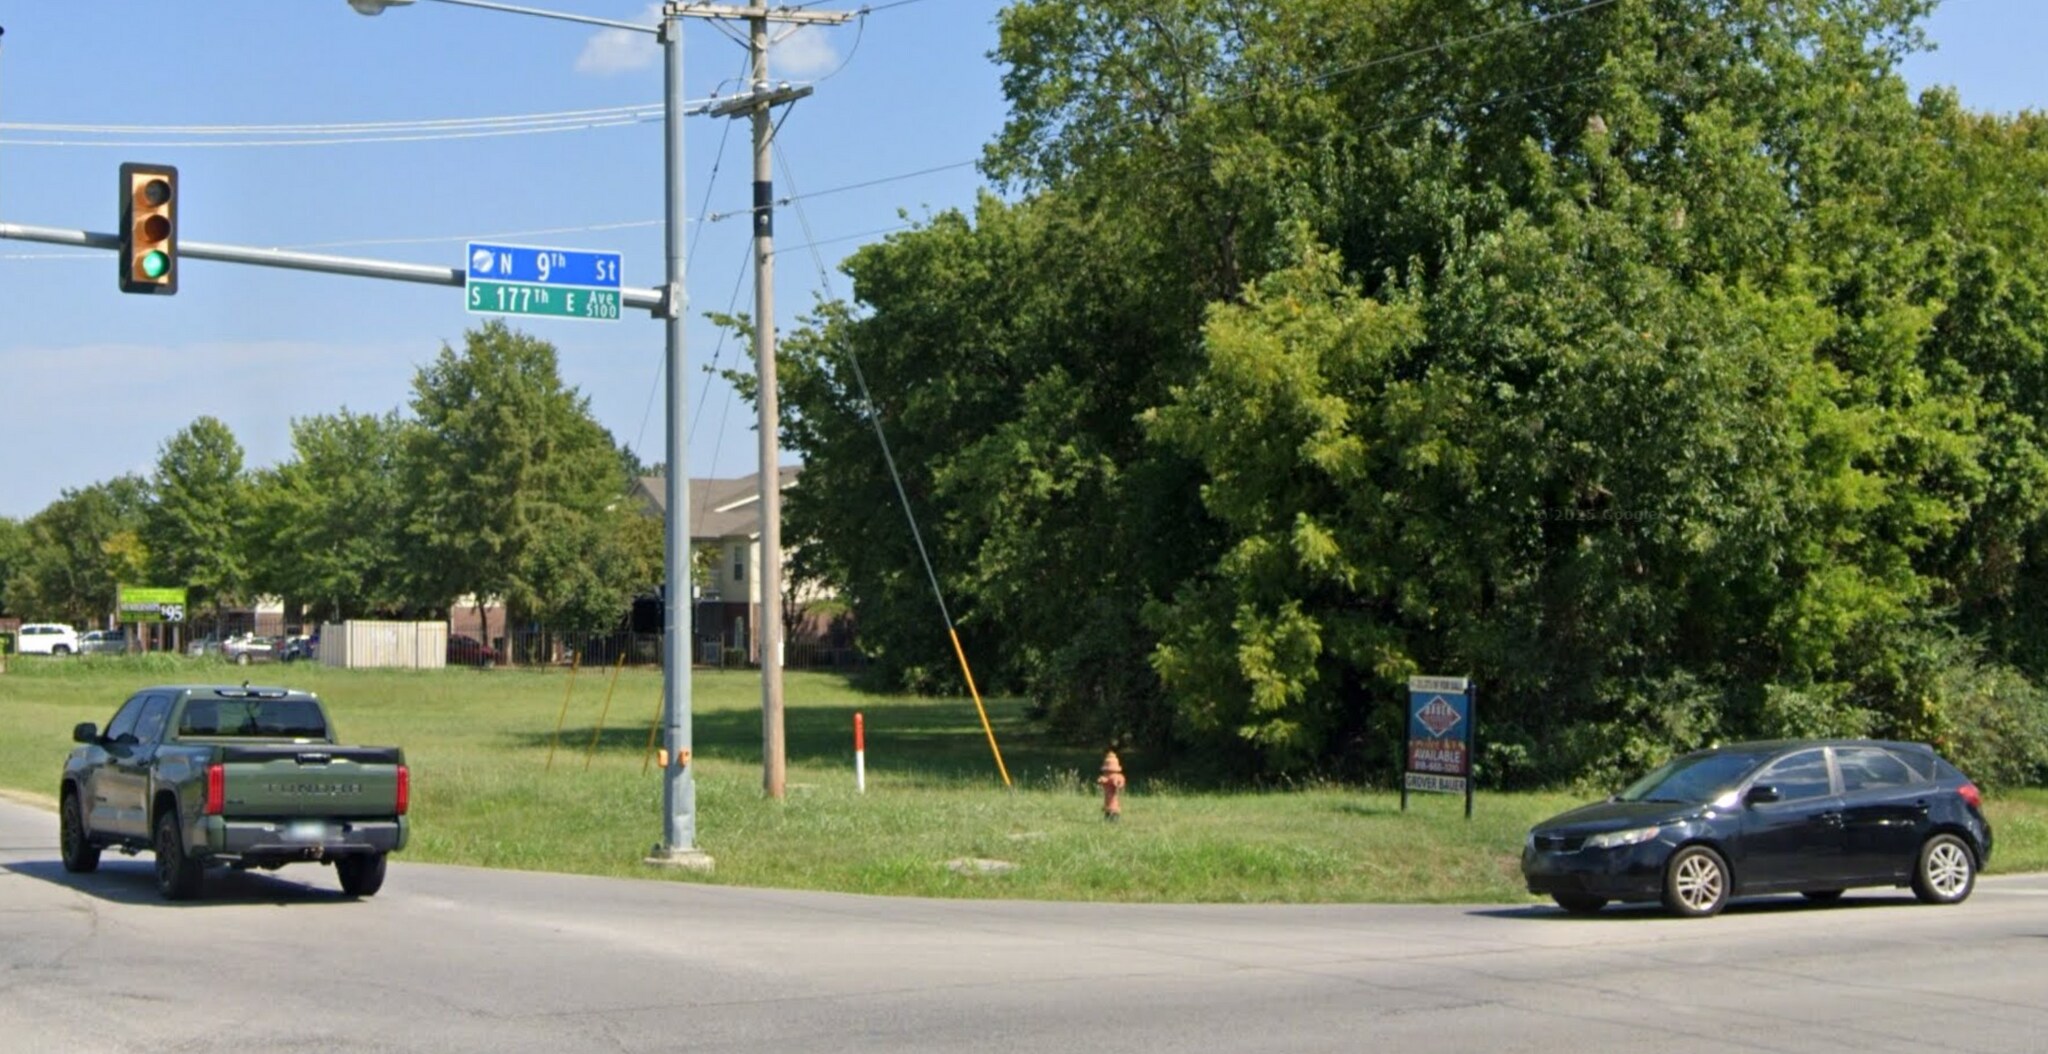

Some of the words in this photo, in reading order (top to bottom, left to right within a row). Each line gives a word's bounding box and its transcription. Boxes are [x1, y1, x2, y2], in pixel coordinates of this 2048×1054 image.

[501, 252, 512, 275] N
[596, 259, 616, 281] St
[471, 286, 481, 306] S
[497, 287, 549, 312] 177Th
[566, 292, 575, 312] E
[589, 290, 614, 305] Ave
[586, 304, 617, 318] 5100
[1414, 749, 1461, 763] AVAILABLE
[1406, 774, 1437, 789] GROVER
[1439, 777, 1466, 792] BAUER
